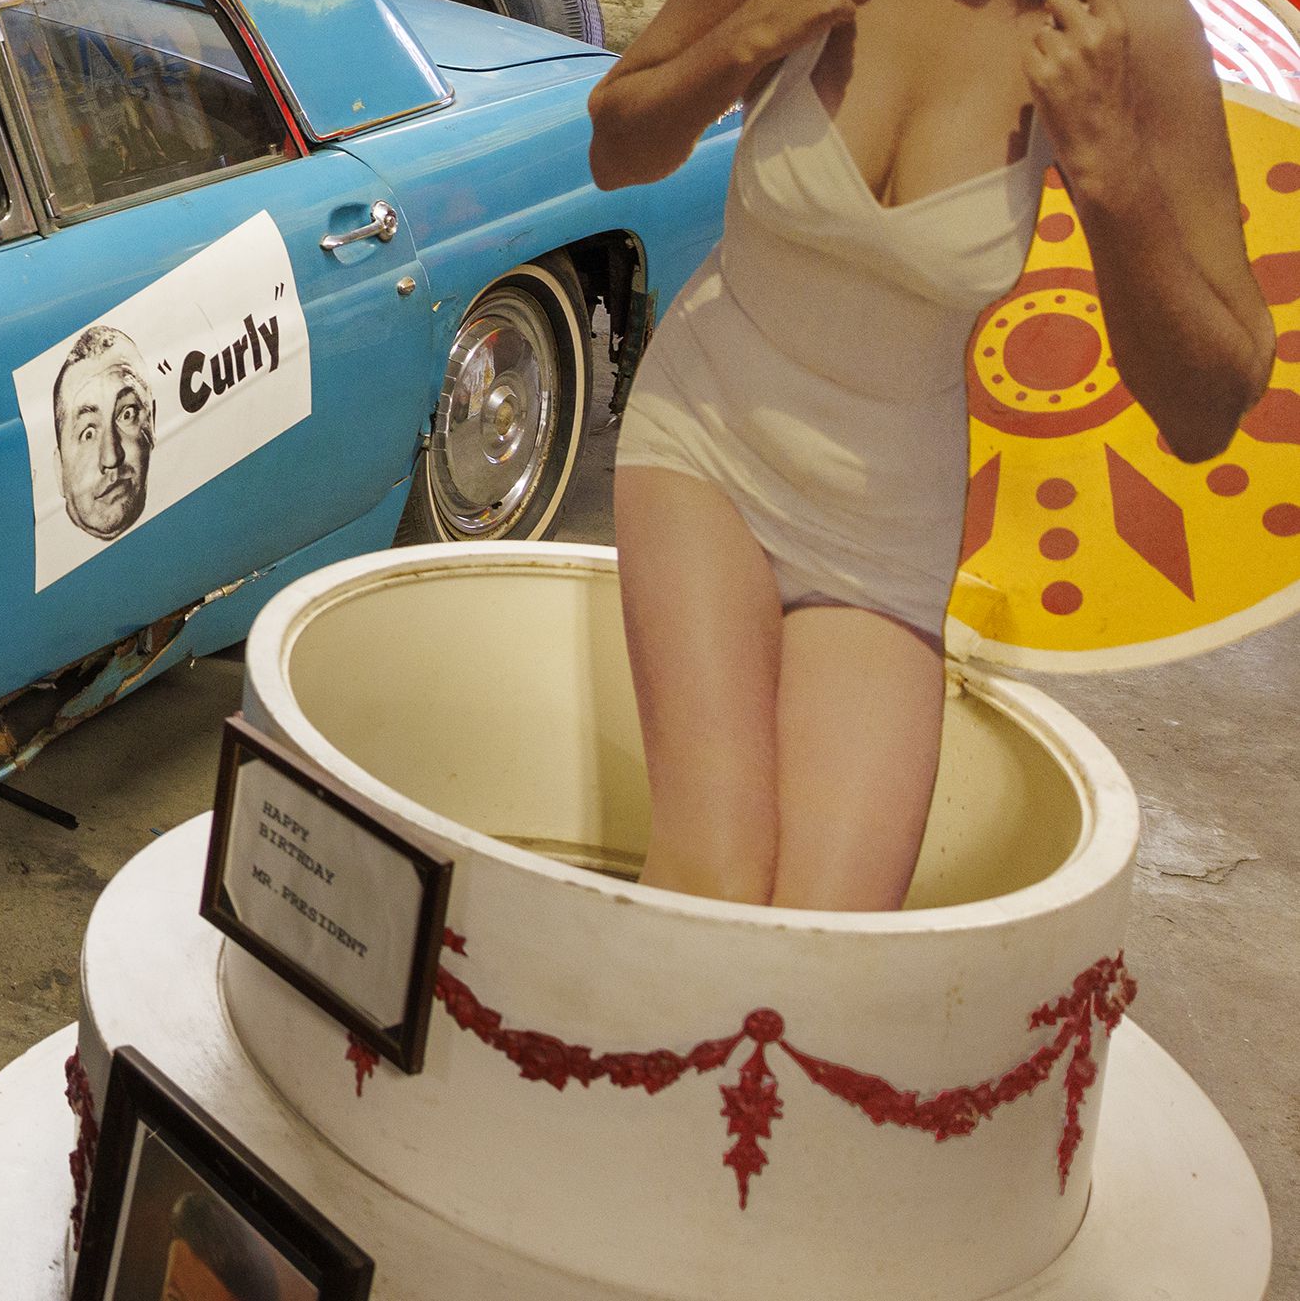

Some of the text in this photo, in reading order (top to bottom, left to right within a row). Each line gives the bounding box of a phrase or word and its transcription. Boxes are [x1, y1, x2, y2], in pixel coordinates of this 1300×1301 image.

[258, 821, 336, 886] BIRTHDAY
[262, 800, 310, 843] HAPPY
[251, 863, 369, 958] MR. PRESIDENT
